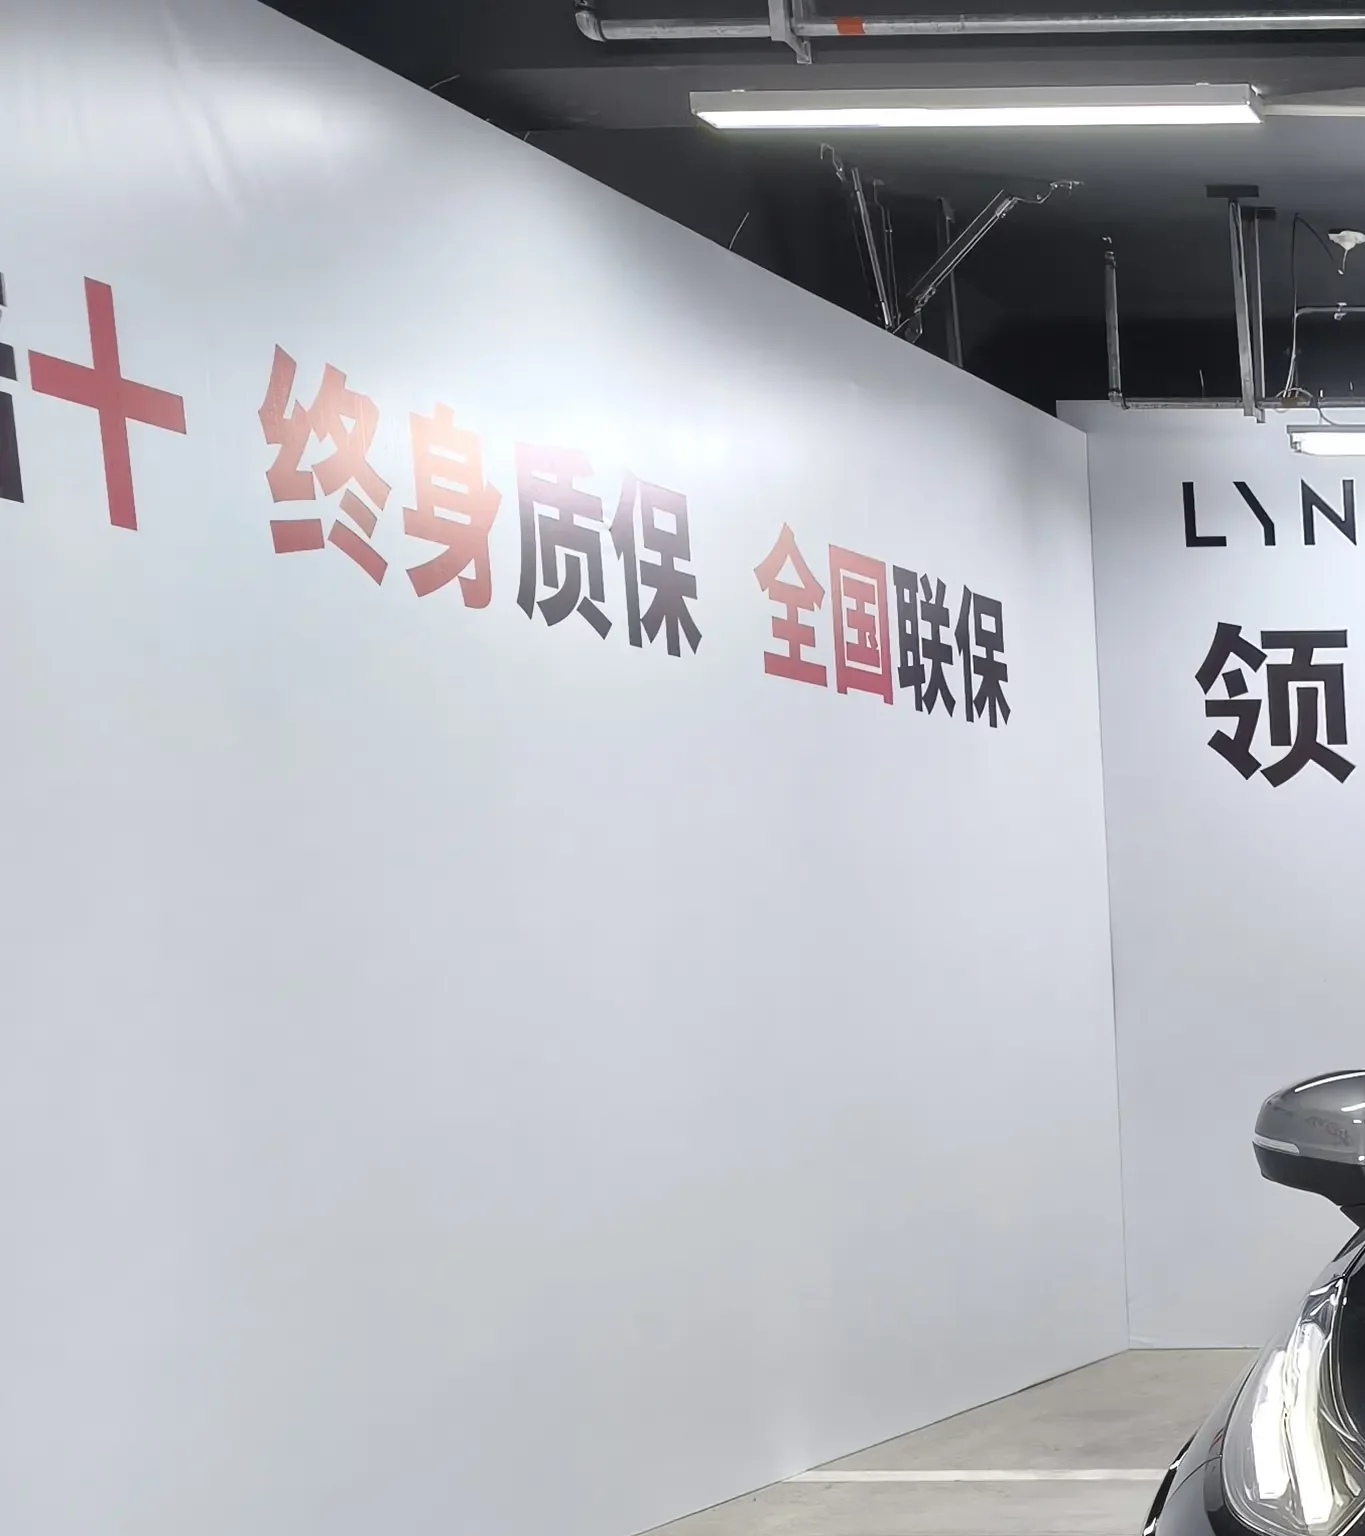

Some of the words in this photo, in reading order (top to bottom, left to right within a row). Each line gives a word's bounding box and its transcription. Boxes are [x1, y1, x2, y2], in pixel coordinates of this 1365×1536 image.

[258, 344, 703, 658] 终身质保
[753, 522, 1011, 728] 全国联保
